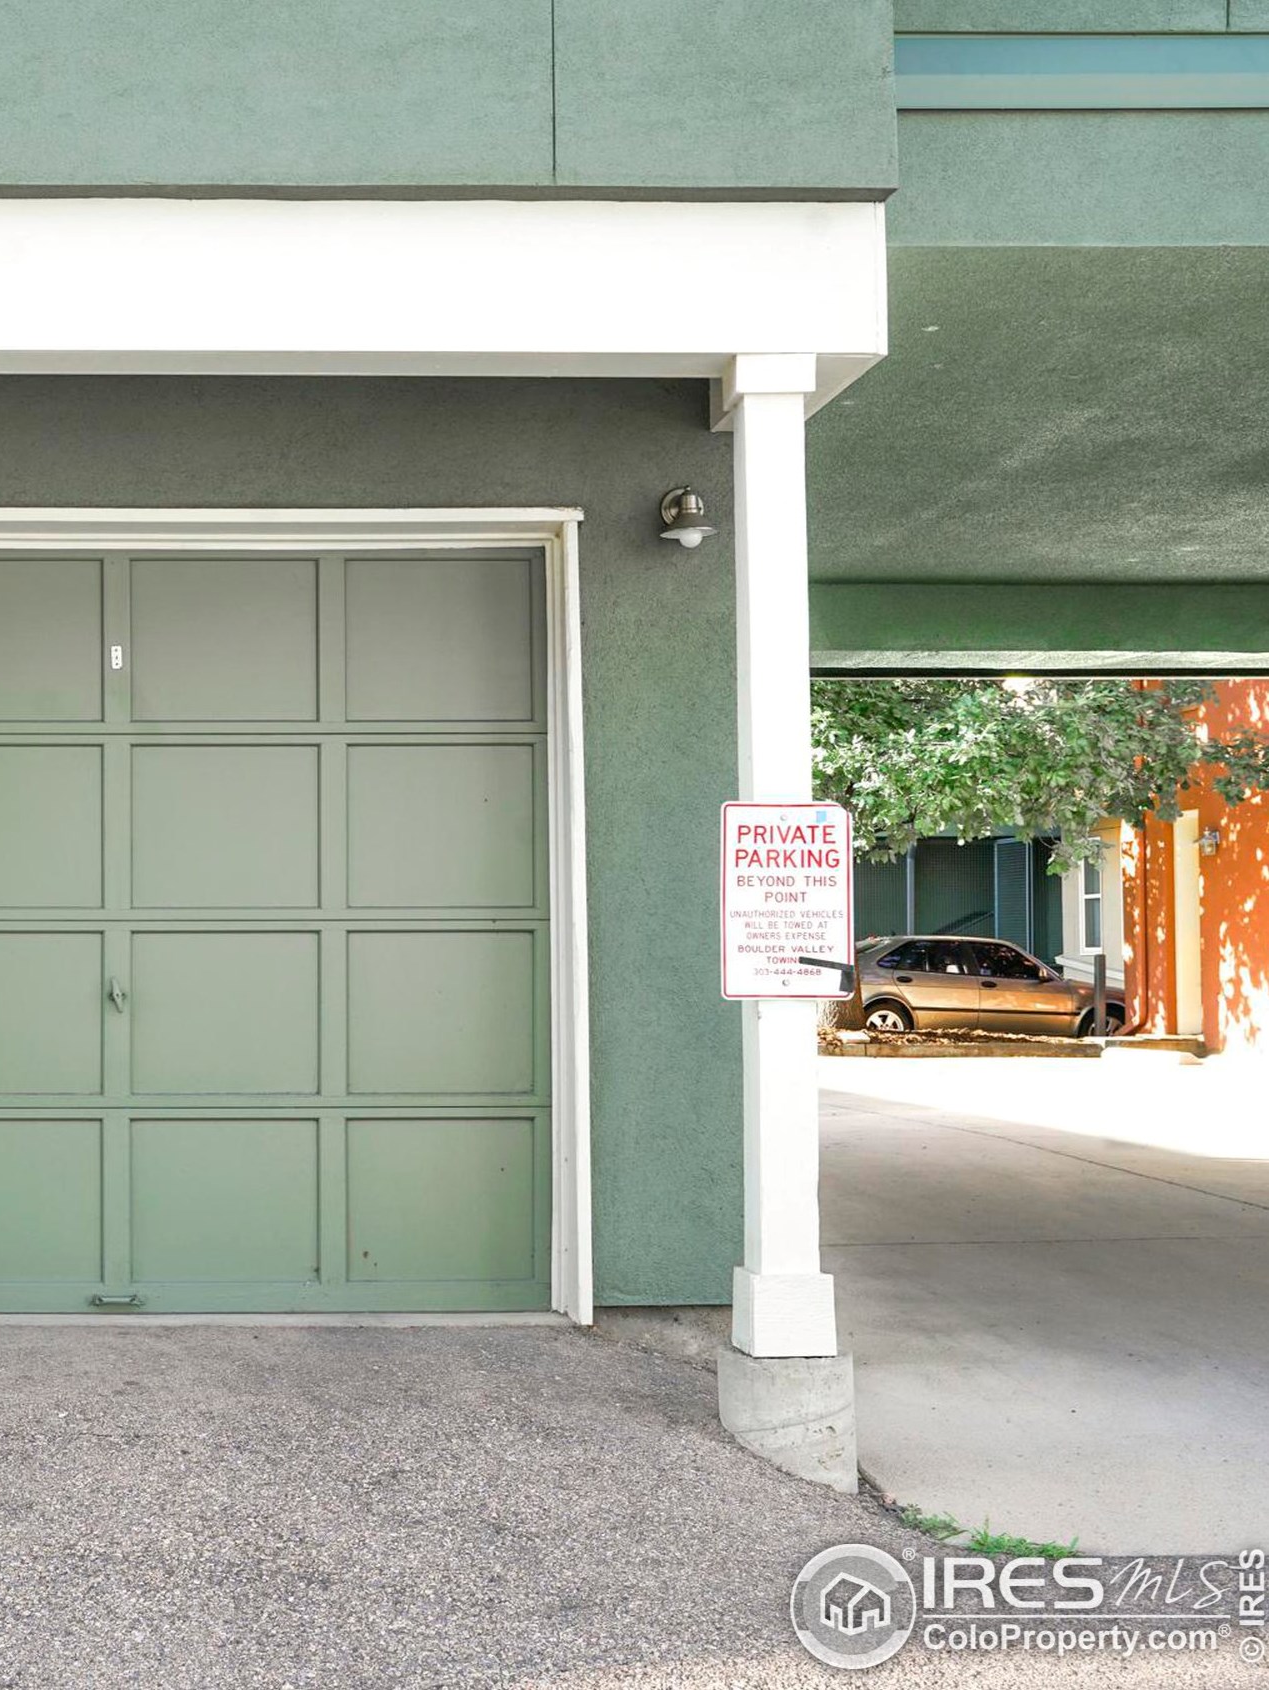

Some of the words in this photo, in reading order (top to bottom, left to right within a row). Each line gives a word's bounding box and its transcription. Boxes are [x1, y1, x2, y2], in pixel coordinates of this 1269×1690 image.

[737, 825, 836, 844] PRIVATE
[735, 849, 840, 868] PARKING
[737, 875, 795, 887] BEYOND
[804, 875, 837, 887] THIS
[764, 891, 807, 903] POINT
[729, 910, 795, 919] UNAUTHORIZED
[800, 910, 844, 919] VEHICLES
[744, 921, 763, 930] WILL
[768, 921, 779, 930] BE
[784, 921, 813, 930] TOWED
[817, 921, 828, 930] AT
[746, 932, 781, 941] OWNERS
[785, 932, 827, 941] EXPENSE
[737, 944, 786, 953] BOULDER
[791, 944, 835, 953] VALLEY
[766, 956, 804, 964] TOWIN
